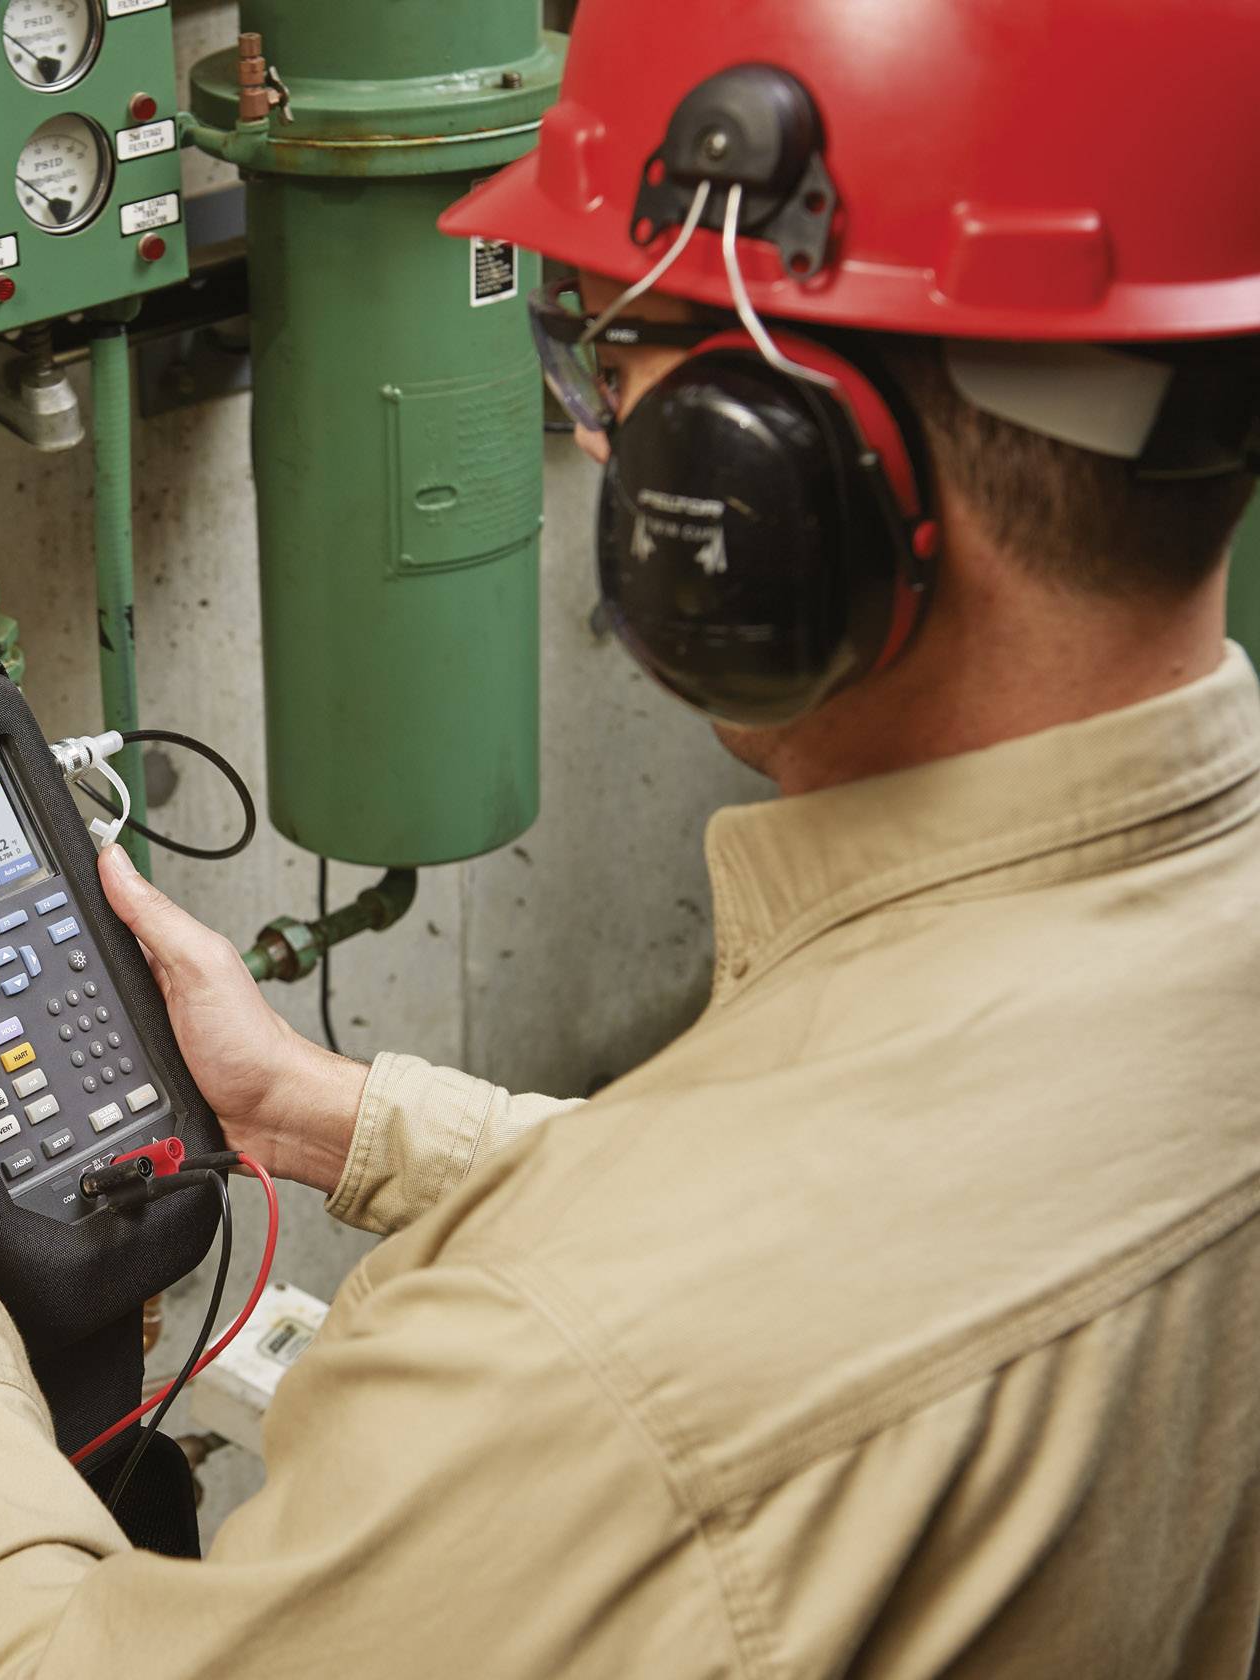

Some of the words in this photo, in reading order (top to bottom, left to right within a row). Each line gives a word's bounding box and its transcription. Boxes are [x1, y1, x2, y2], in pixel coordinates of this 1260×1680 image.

[4, 868, 16, 876] Auto
[56, 922, 77, 936] SELECT
[1, 1024, 17, 1036] HOLD
[13, 1050, 28, 1062] HART
[28, 1078, 38, 1087] mA
[39, 1103, 52, 1113] VDC
[52, 1135, 70, 1148] SETUP
[12, 1155, 32, 1170] TASKS
[63, 1193, 76, 1204] COM
